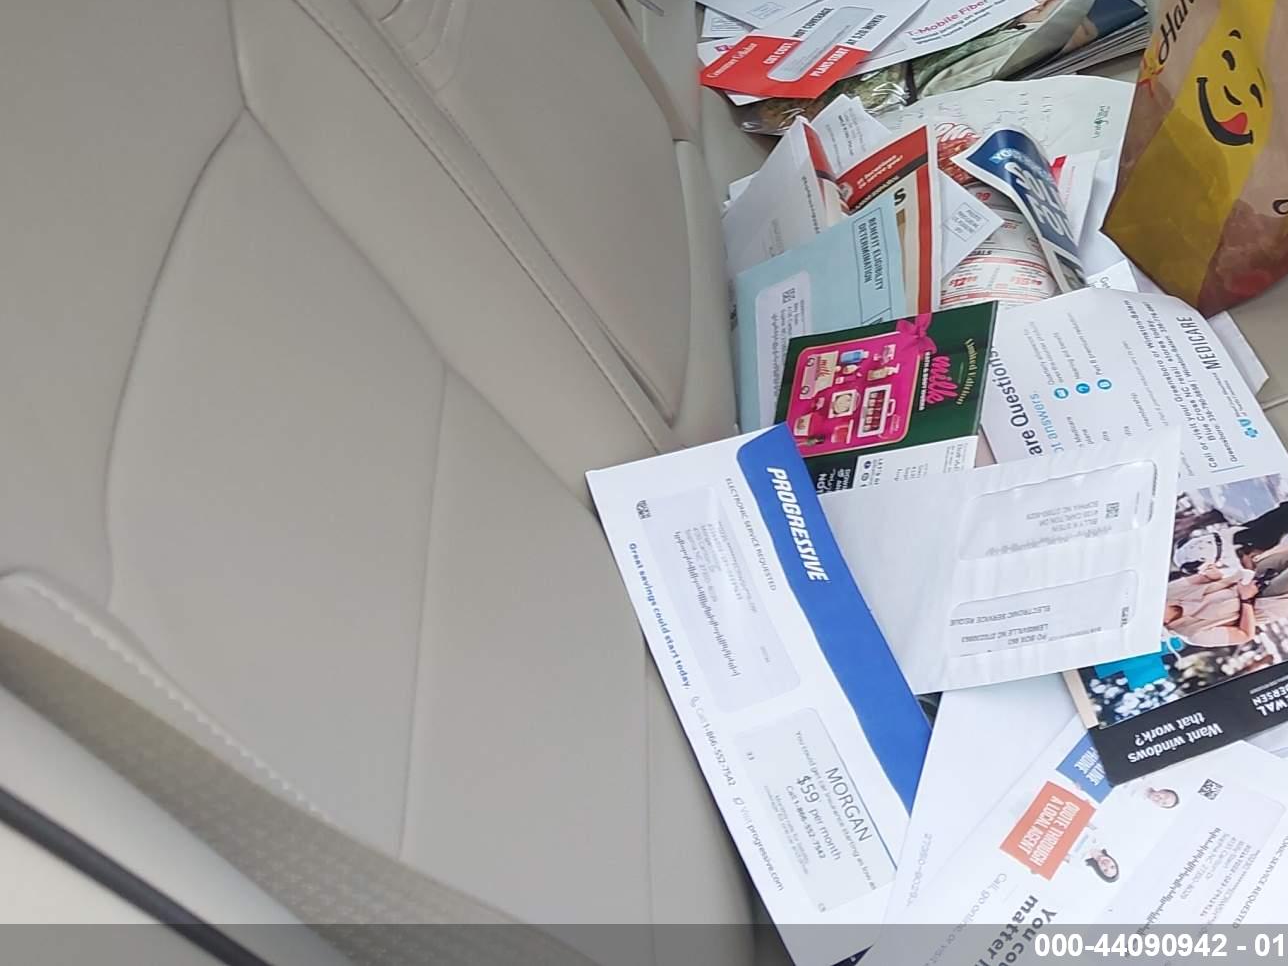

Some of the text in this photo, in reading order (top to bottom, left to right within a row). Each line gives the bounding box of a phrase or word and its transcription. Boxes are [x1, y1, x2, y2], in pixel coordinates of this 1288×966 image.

[905, 14, 959, 36] T-Mobile
[858, 223, 873, 283] DETERMINATION
[867, 216, 884, 290] BENEFIT ELIGIBILITY
[1123, 298, 1155, 349] Winston-Salem
[1176, 312, 1221, 372] MEDICARE
[1157, 340, 1173, 362] stores
[1156, 358, 1183, 402] Greensboro
[1170, 365, 1186, 385] retail
[1180, 385, 1192, 398] NC
[1178, 401, 1196, 421] your
[1188, 398, 1205, 422] Cross
[1019, 428, 1043, 457] are
[1188, 421, 1203, 440] visit
[1200, 423, 1216, 442] Blue
[1203, 451, 1217, 468] Call
[724, 476, 778, 592] ELECTRONIC SERVICE REQUESTED
[767, 467, 829, 582] PROGRESSIVE
[627, 541, 645, 569] Great
[636, 568, 659, 607] savings
[652, 606, 670, 634] could
[663, 633, 680, 659] start
[1126, 721, 1222, 765] Want windows
[1133, 711, 1205, 746] that work?
[797, 776, 843, 861] $59 per month
[800, 744, 816, 767] could
[840, 827, 860, 857] starting
[825, 767, 873, 842] MORGAN
[1032, 800, 1060, 832] LOCAL
[1016, 824, 1044, 855] AGENT
[1028, 800, 1080, 867] QUOTE THROUGH
[745, 822, 784, 892] progressive.com
[1257, 855, 1279, 886] SERVICE
[974, 888, 991, 906] go
[1230, 884, 1262, 930] REQUESTED
[988, 895, 1039, 960] matter
[1022, 907, 1057, 942] You
